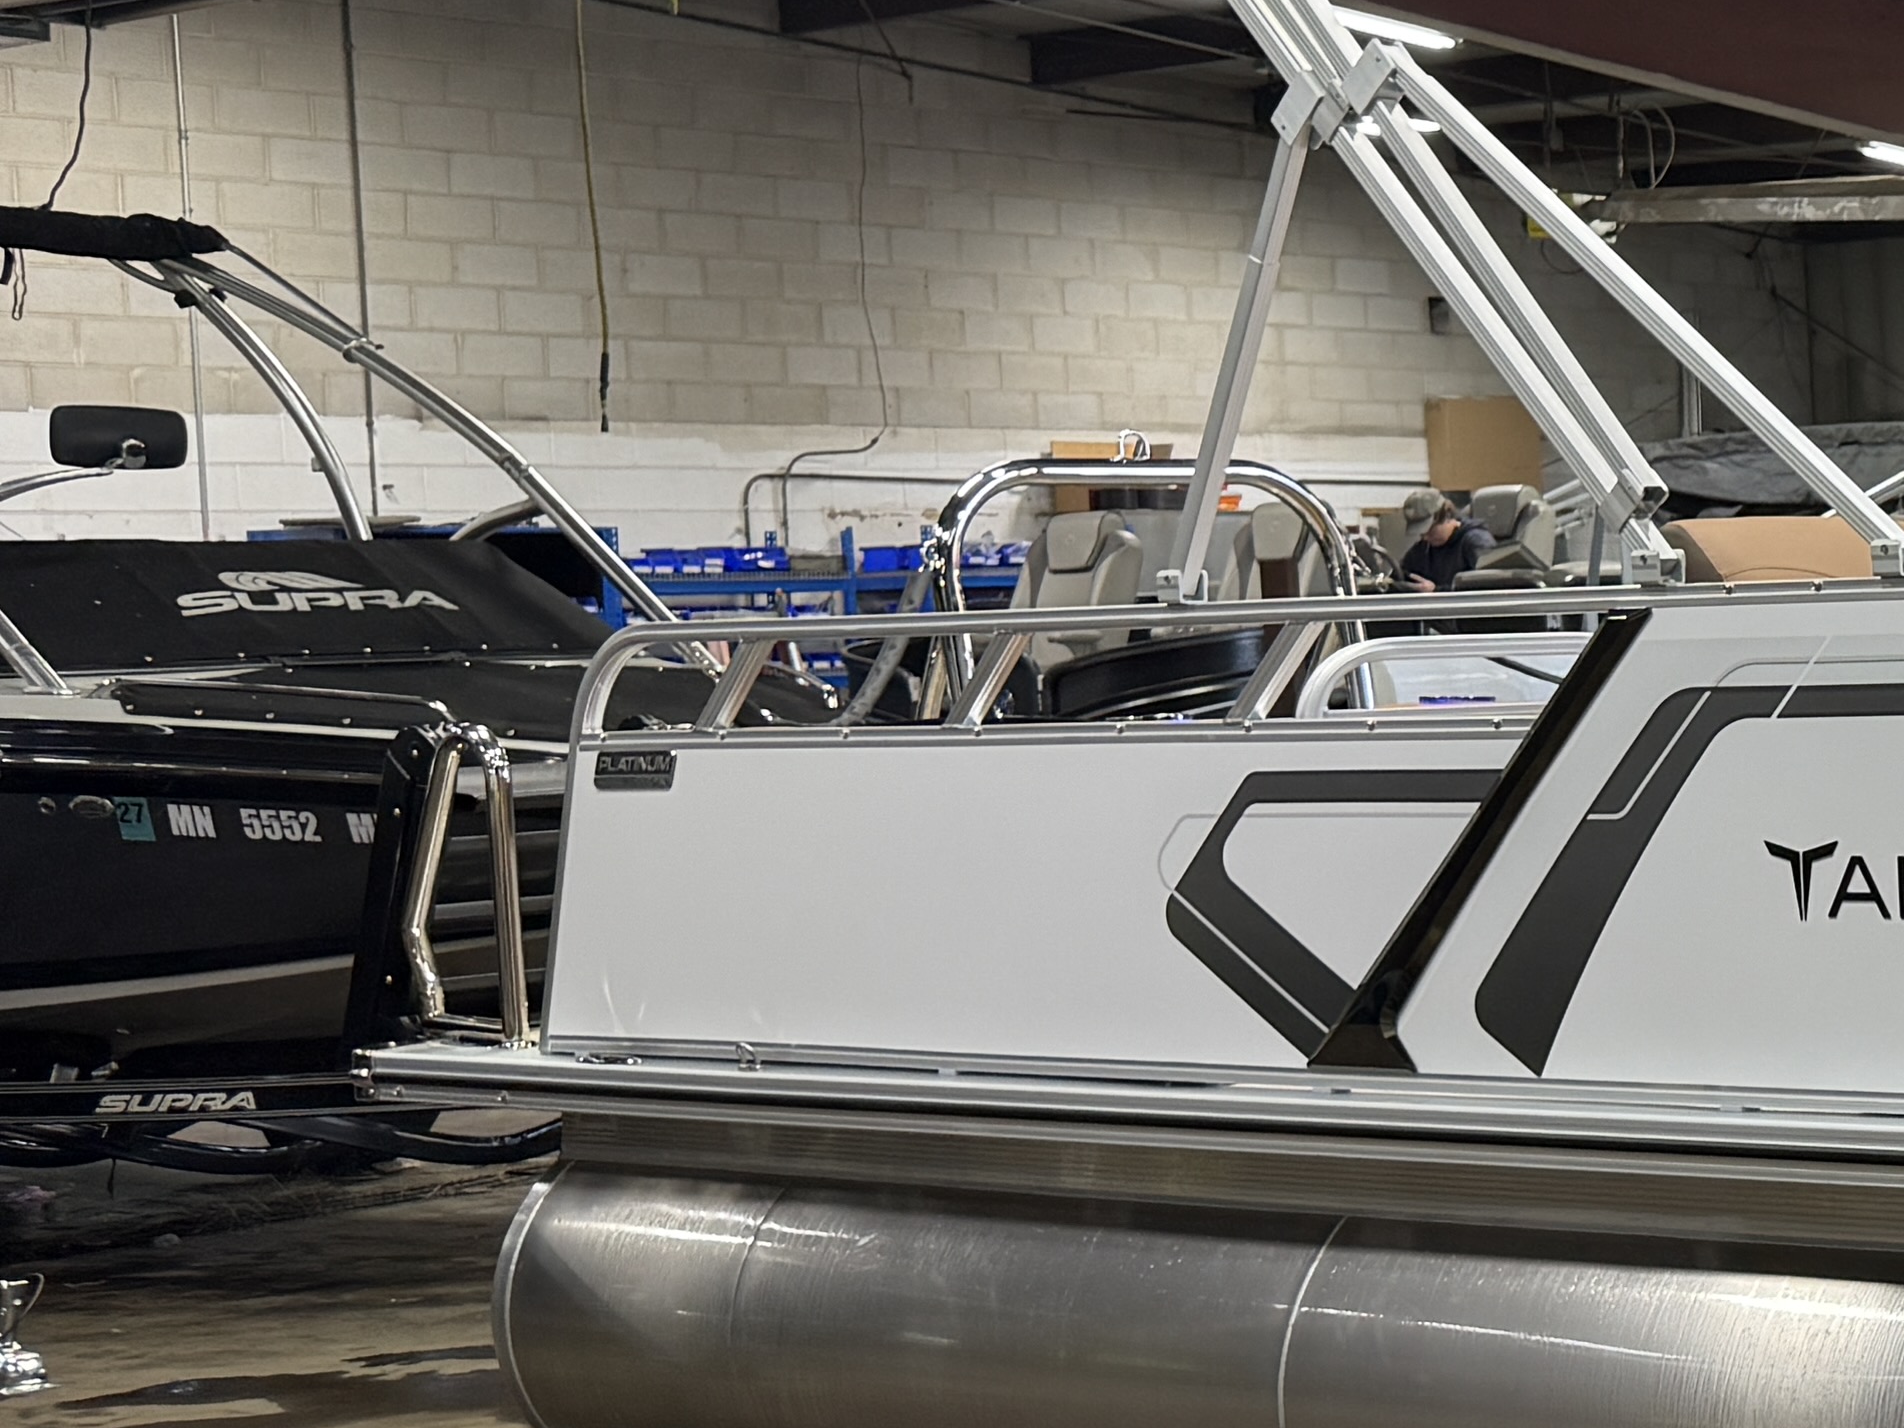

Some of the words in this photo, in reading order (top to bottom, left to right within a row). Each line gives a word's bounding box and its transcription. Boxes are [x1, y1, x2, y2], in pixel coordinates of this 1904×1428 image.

[176, 589, 460, 617] SUPRA
[600, 755, 671, 772] PLATINUM
[117, 802, 143, 824] 27
[166, 803, 217, 839] MN
[239, 807, 323, 842] 5552
[345, 812, 378, 844] M
[95, 1091, 257, 1114] SUPRA
